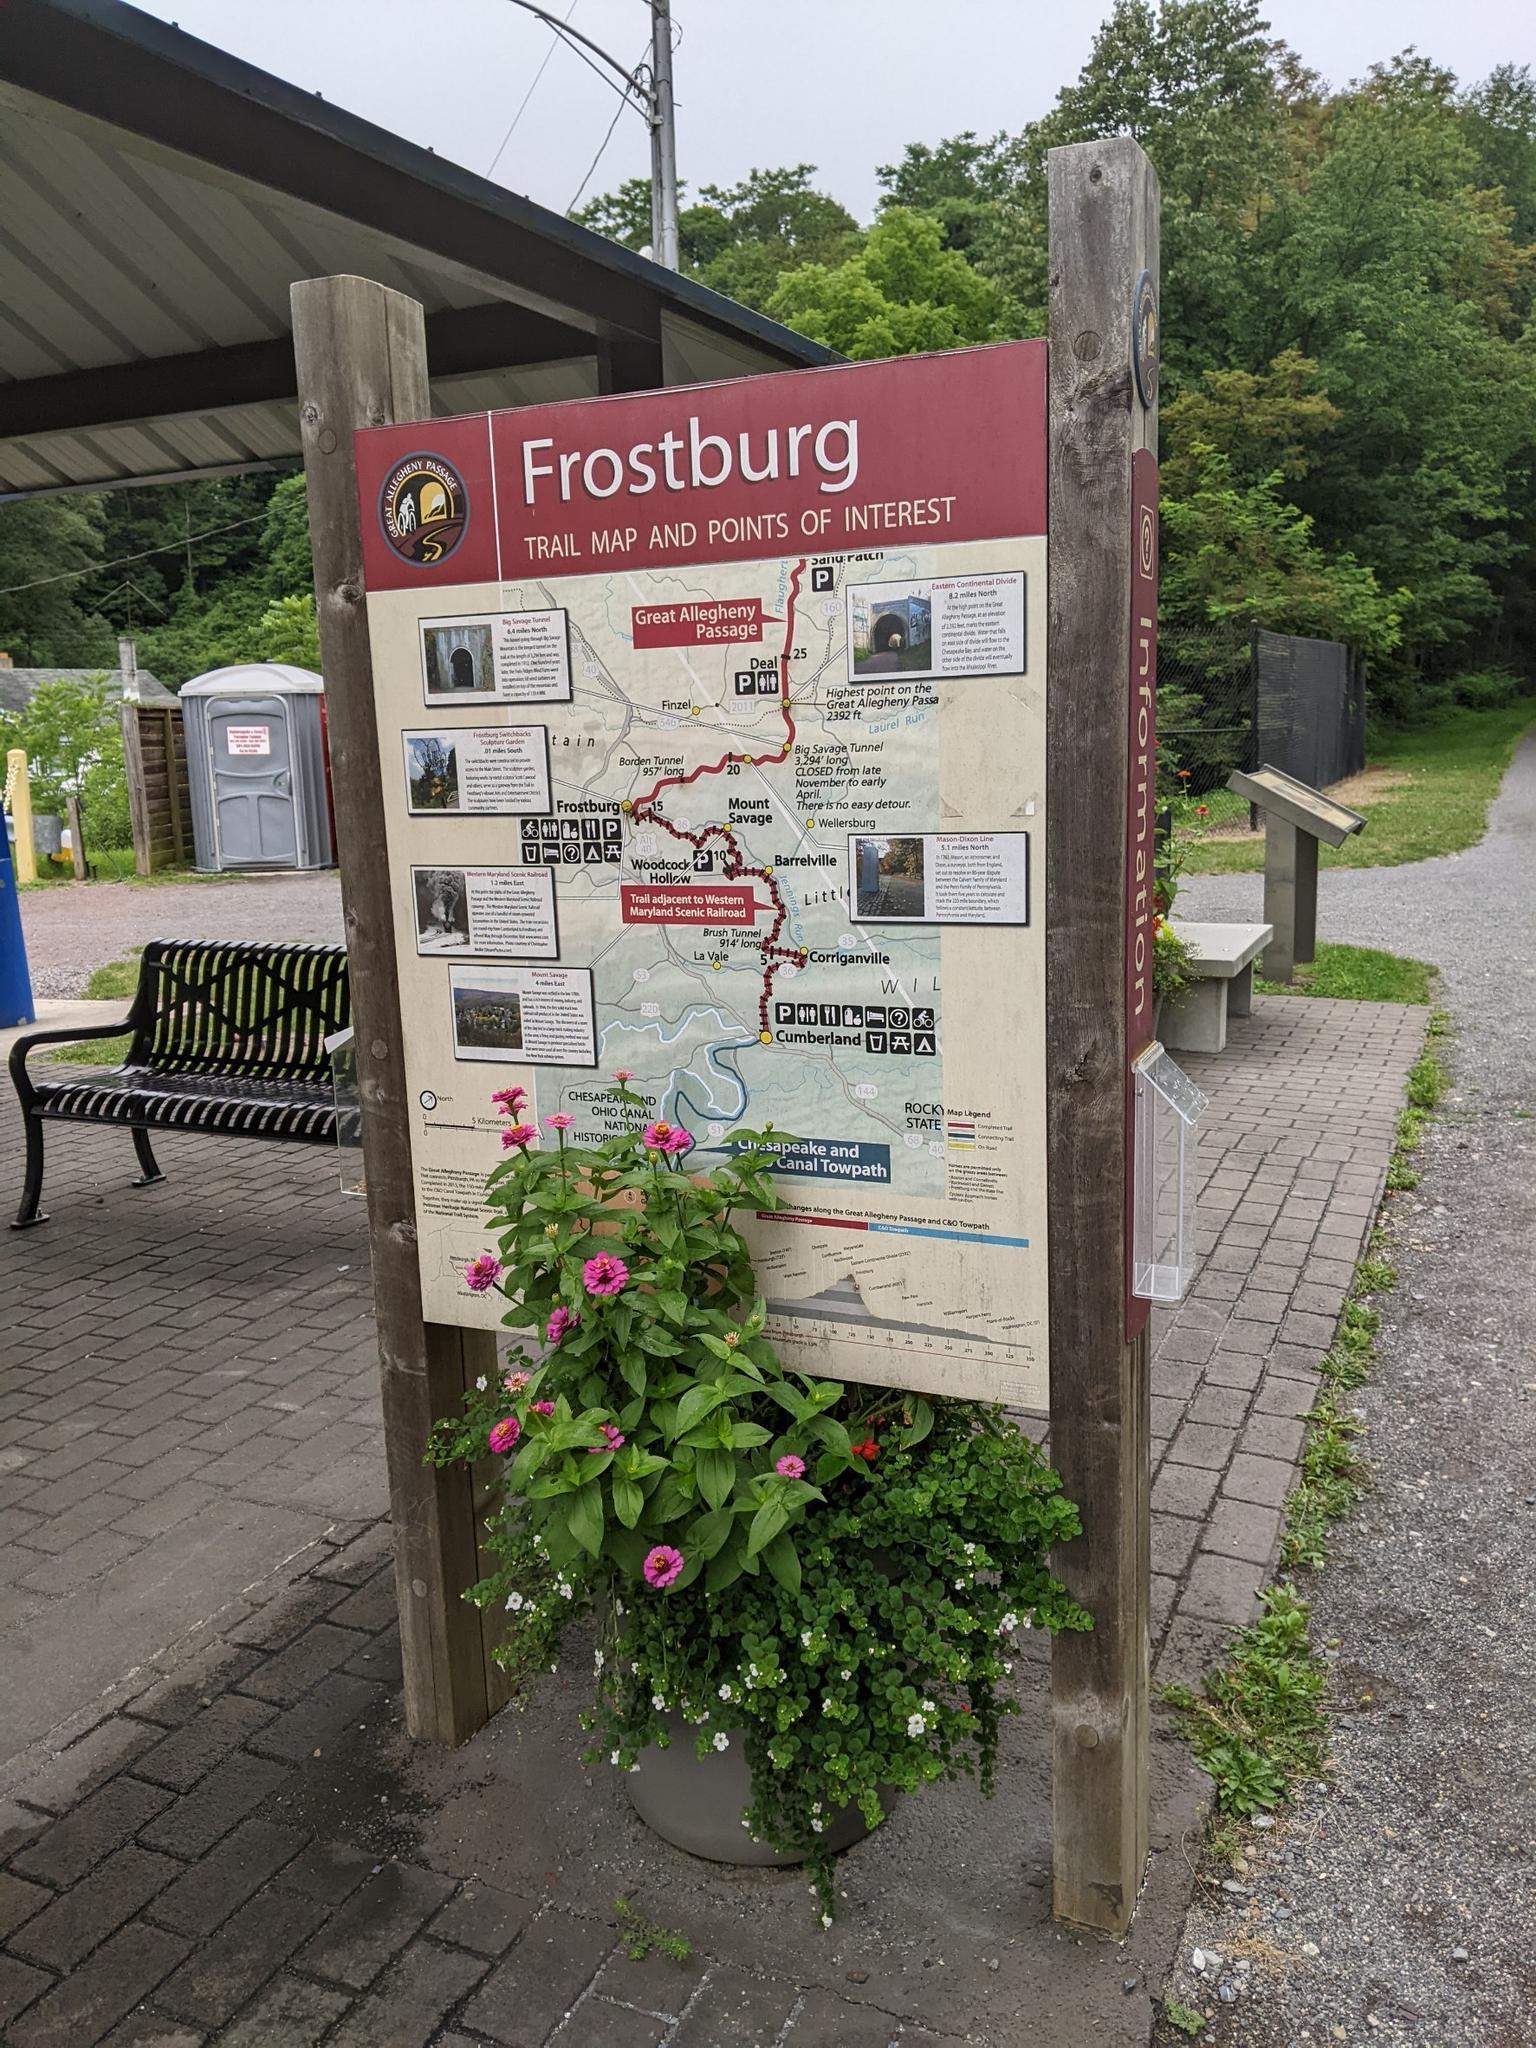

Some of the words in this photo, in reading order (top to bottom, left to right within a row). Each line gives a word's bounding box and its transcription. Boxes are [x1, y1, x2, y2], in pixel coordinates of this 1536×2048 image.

[523, 416, 858, 504] Frostburg
[385, 461, 423, 502] ALLEGHENY
[426, 460, 458, 491] PASSAGE
[385, 506, 399, 538] GREAT
[524, 533, 581, 560] TRAIL
[591, 527, 637, 555] MAP
[649, 522, 697, 550] AND
[709, 512, 789, 544] POINTS
[801, 508, 831, 536] OF
[845, 496, 956, 532] INTEREST
[931, 582, 956, 591] Eastern
[957, 579, 995, 589] Continental
[996, 577, 1017, 586] Divide
[959, 591, 977, 599] miles
[978, 589, 997, 597] North
[635, 609, 676, 625] Great
[679, 604, 756, 625] Allegheny
[502, 618, 511, 626] Big
[512, 617, 532, 626] Savage
[696, 623, 758, 640] Passage
[793, 648, 807, 659] 25
[750, 656, 778, 670] Deal
[826, 687, 864, 699] Highest
[866, 686, 895, 698] point
[899, 686, 911, 694] on
[914, 683, 932, 693] the
[662, 699, 691, 710] Finzel
[826, 699, 855, 710] Great
[858, 696, 909, 709] Allegheny
[912, 695, 939, 705] Passa
[826, 711, 850, 721] 2392
[852, 710, 861, 720] ft
[868, 718, 900, 735] Laurel
[905, 712, 925, 725] Run
[473, 731, 499, 739] Frostburg
[480, 738, 504, 746] Sculpture
[794, 744, 810, 755] Big
[813, 744, 848, 755] Savage
[850, 742, 883, 753] Tunnel
[619, 757, 652, 766] Borden
[653, 756, 684, 766] Tunnel
[826, 755, 848, 767] long
[642, 767, 662, 777] 957'
[664, 766, 685, 778] long
[727, 764, 740, 775] 20
[795, 767, 833, 777] CLOSED
[836, 766, 860, 777] from
[862, 766, 882, 775] late
[795, 778, 845, 788] November
[848, 779, 859, 787] to
[861, 777, 887, 789] early
[796, 789, 822, 801] April.
[556, 800, 620, 816] Frostburg
[652, 801, 664, 812] 15
[728, 798, 770, 810] Mount
[796, 800, 824, 811] There
[826, 801, 833, 810] is
[835, 802, 849, 810] no
[851, 802, 873, 812] easy
[875, 799, 911, 810] detour.
[728, 813, 773, 827] Savage
[1134, 617, 1152, 1016] Information
[818, 818, 876, 829] Wellersburg
[980, 835, 995, 843] Line
[631, 859, 691, 871] Woodcock
[713, 851, 726, 861] 10
[774, 854, 837, 867] Barrelville
[487, 871, 510, 879] Maryland
[650, 872, 691, 884] Hollow
[630, 894, 650, 904] Trail
[652, 894, 692, 907] adjacent
[694, 895, 703, 904] to
[705, 895, 744, 905] Western
[630, 906, 674, 919] Maryland
[675, 907, 705, 917] Scenic
[706, 907, 746, 918] Railroad
[779, 875, 800, 918] Jennings
[795, 922, 805, 943] Run
[703, 928, 728, 938] Brush
[731, 929, 762, 939] Tunnel
[719, 939, 739, 949] 914'
[740, 939, 762, 951] long
[842, 936, 853, 946] 35
[694, 952, 705, 961] La
[708, 953, 729, 961] Vale
[760, 954, 768, 965] 5
[809, 951, 891, 966] Corriganville
[549, 971, 568, 980] Savage
[782, 966, 794, 975] 36
[776, 1030, 861, 1047] Cumberland
[568, 1091, 632, 1104] CHESAPEA
[641, 1095, 657, 1106] ND
[591, 1106, 618, 1117] OHIO
[620, 1109, 655, 1120] CANAL
[947, 1109, 963, 1118] Map
[964, 1110, 991, 1119] Legend
[471, 1116, 477, 1124] 5
[477, 1118, 512, 1127] Kilometers
[604, 1121, 648, 1132] NATIONA
[906, 1117, 942, 1131] STATE
[830, 1144, 859, 1159] and
[776, 1156, 818, 1172] Canal
[820, 1159, 888, 1179] Towpath
[788, 1204, 812, 1214] hanges
[813, 1205, 832, 1216] along
[832, 1208, 844, 1216] the
[844, 1209, 864, 1217] Great
[864, 1210, 898, 1222] Allegheny
[899, 1214, 927, 1225] Passage
[927, 1217, 941, 1226] and
[942, 1218, 958, 1227] C&O
[959, 1220, 990, 1231] Towpath
